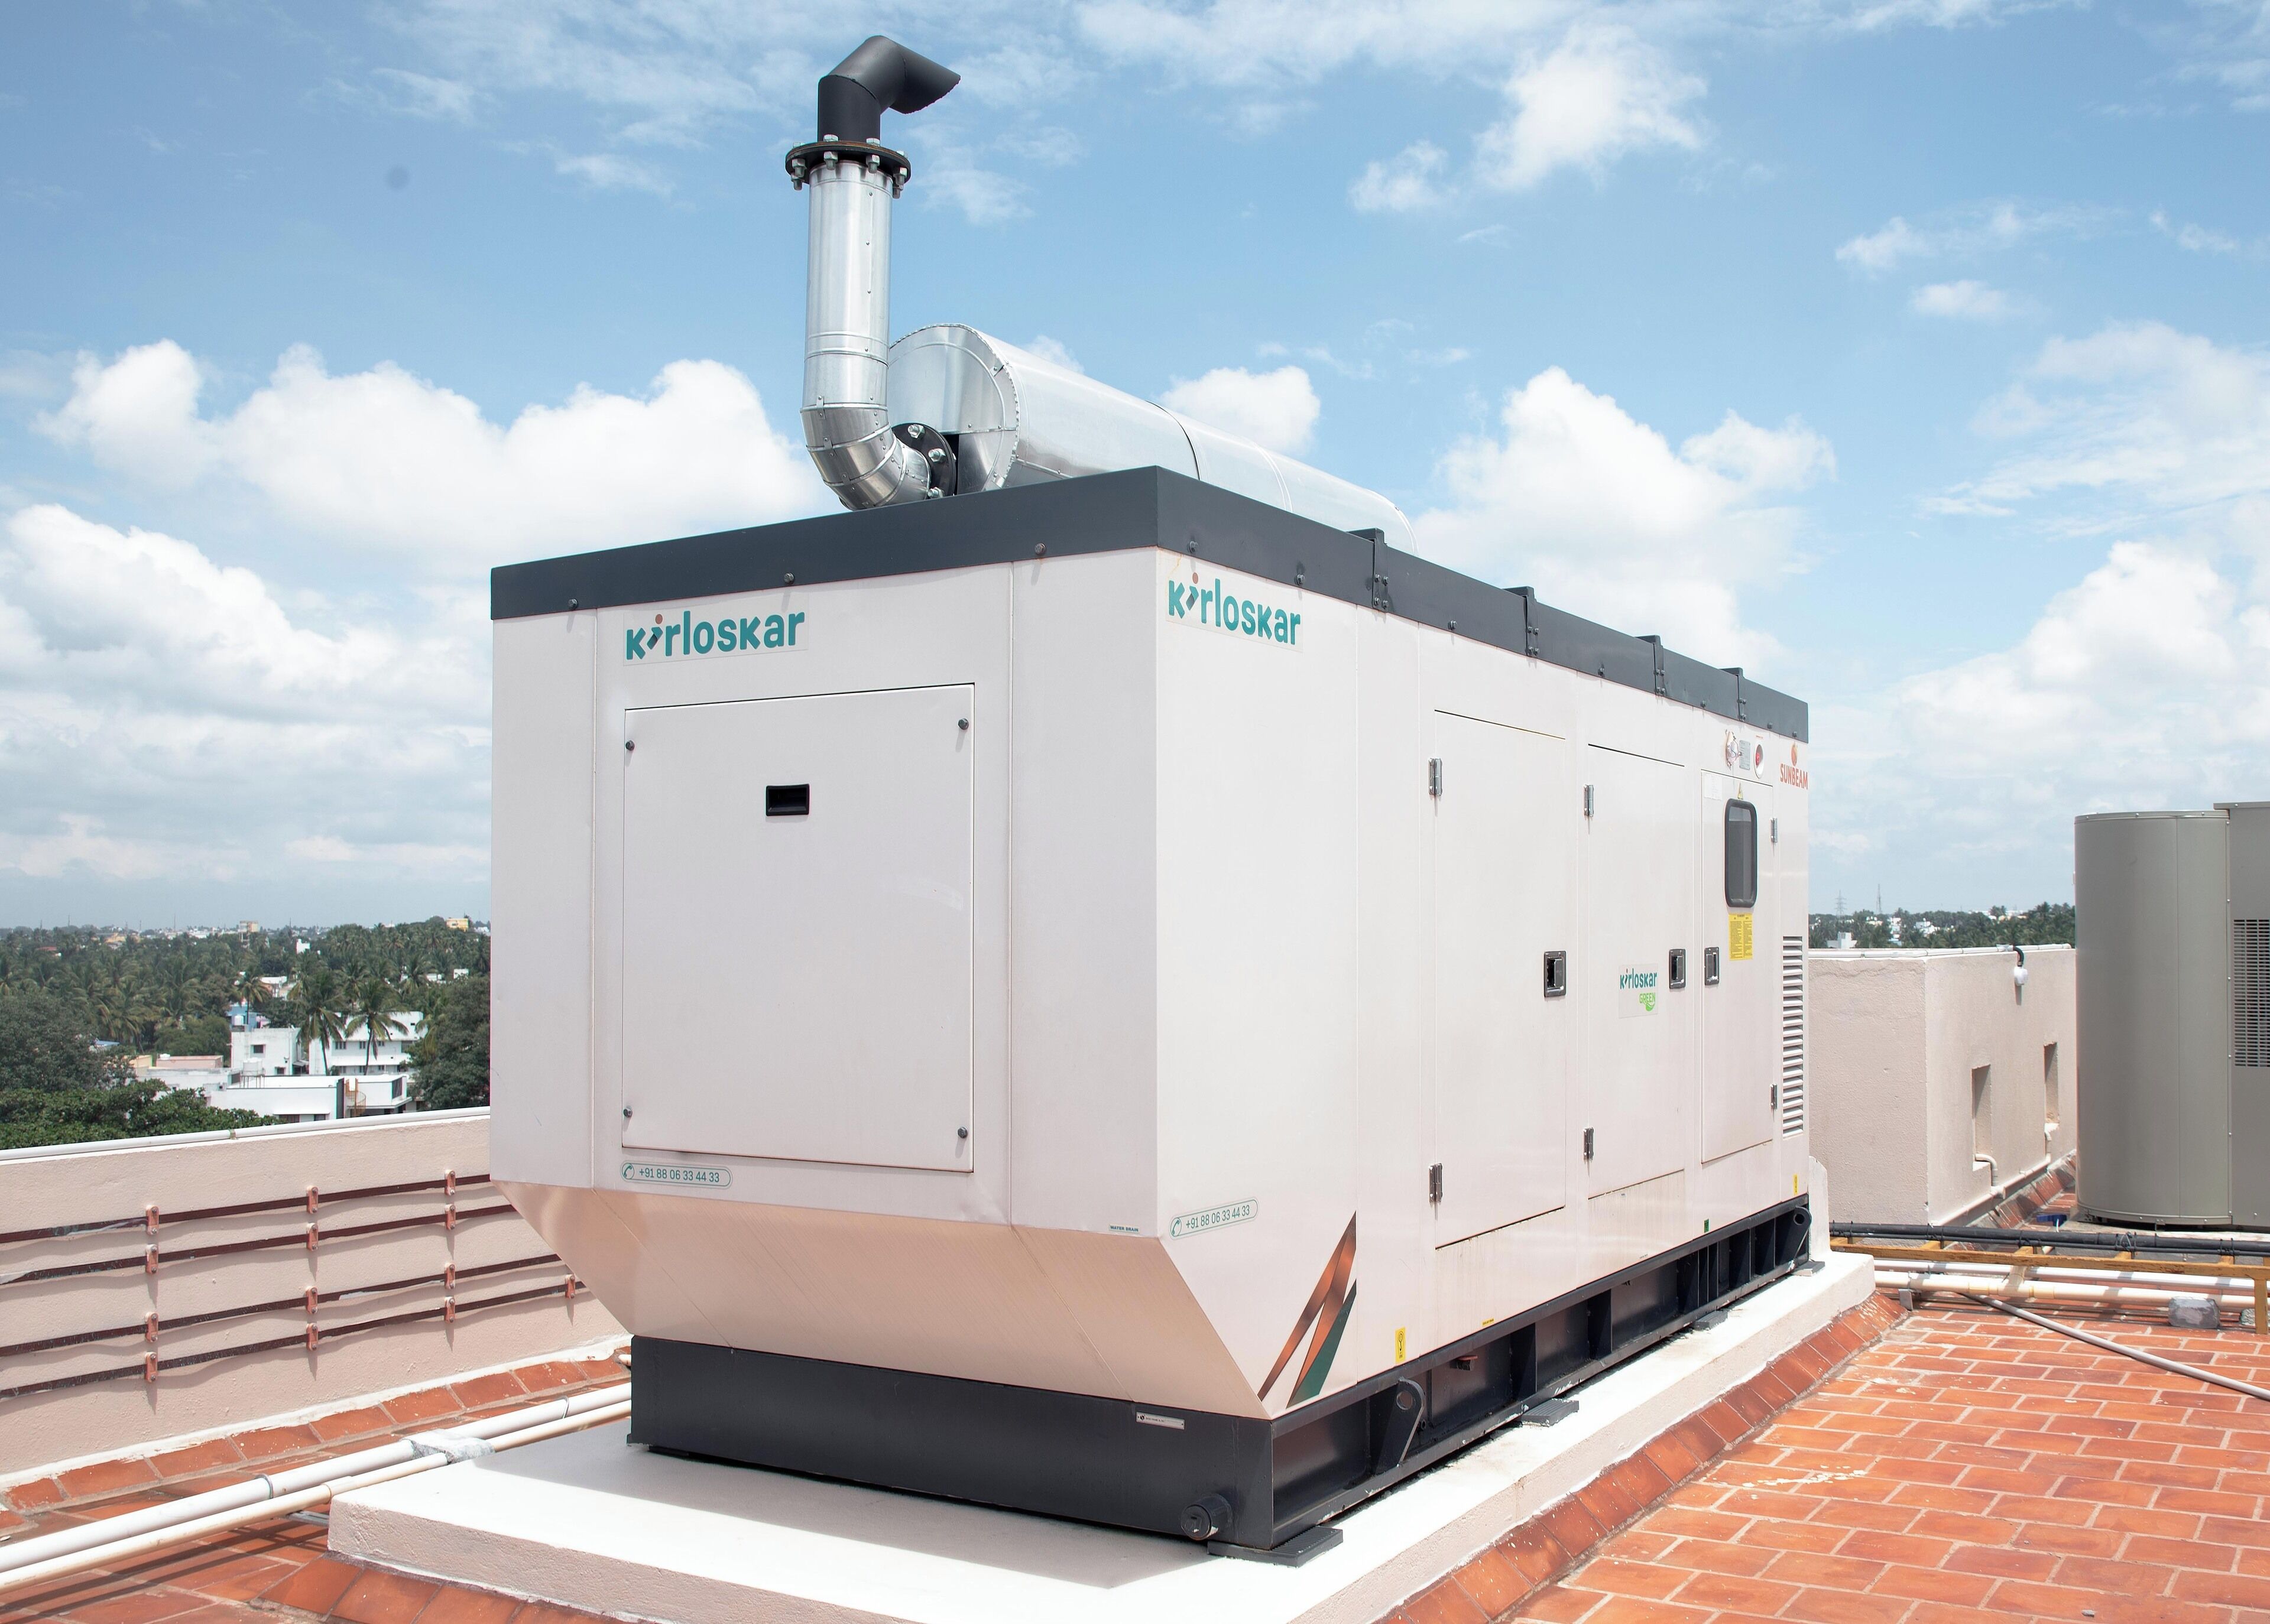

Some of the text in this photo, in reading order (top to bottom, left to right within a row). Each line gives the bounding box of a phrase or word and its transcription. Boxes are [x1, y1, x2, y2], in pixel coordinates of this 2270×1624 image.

[1780, 763, 1808, 790] SUNBEAM
[1639, 992, 1656, 1004] GREEN
[639, 1167, 720, 1183] +91 88 06 33 44 33
[1186, 1204, 1250, 1230] +91 88 06 33 44 33
